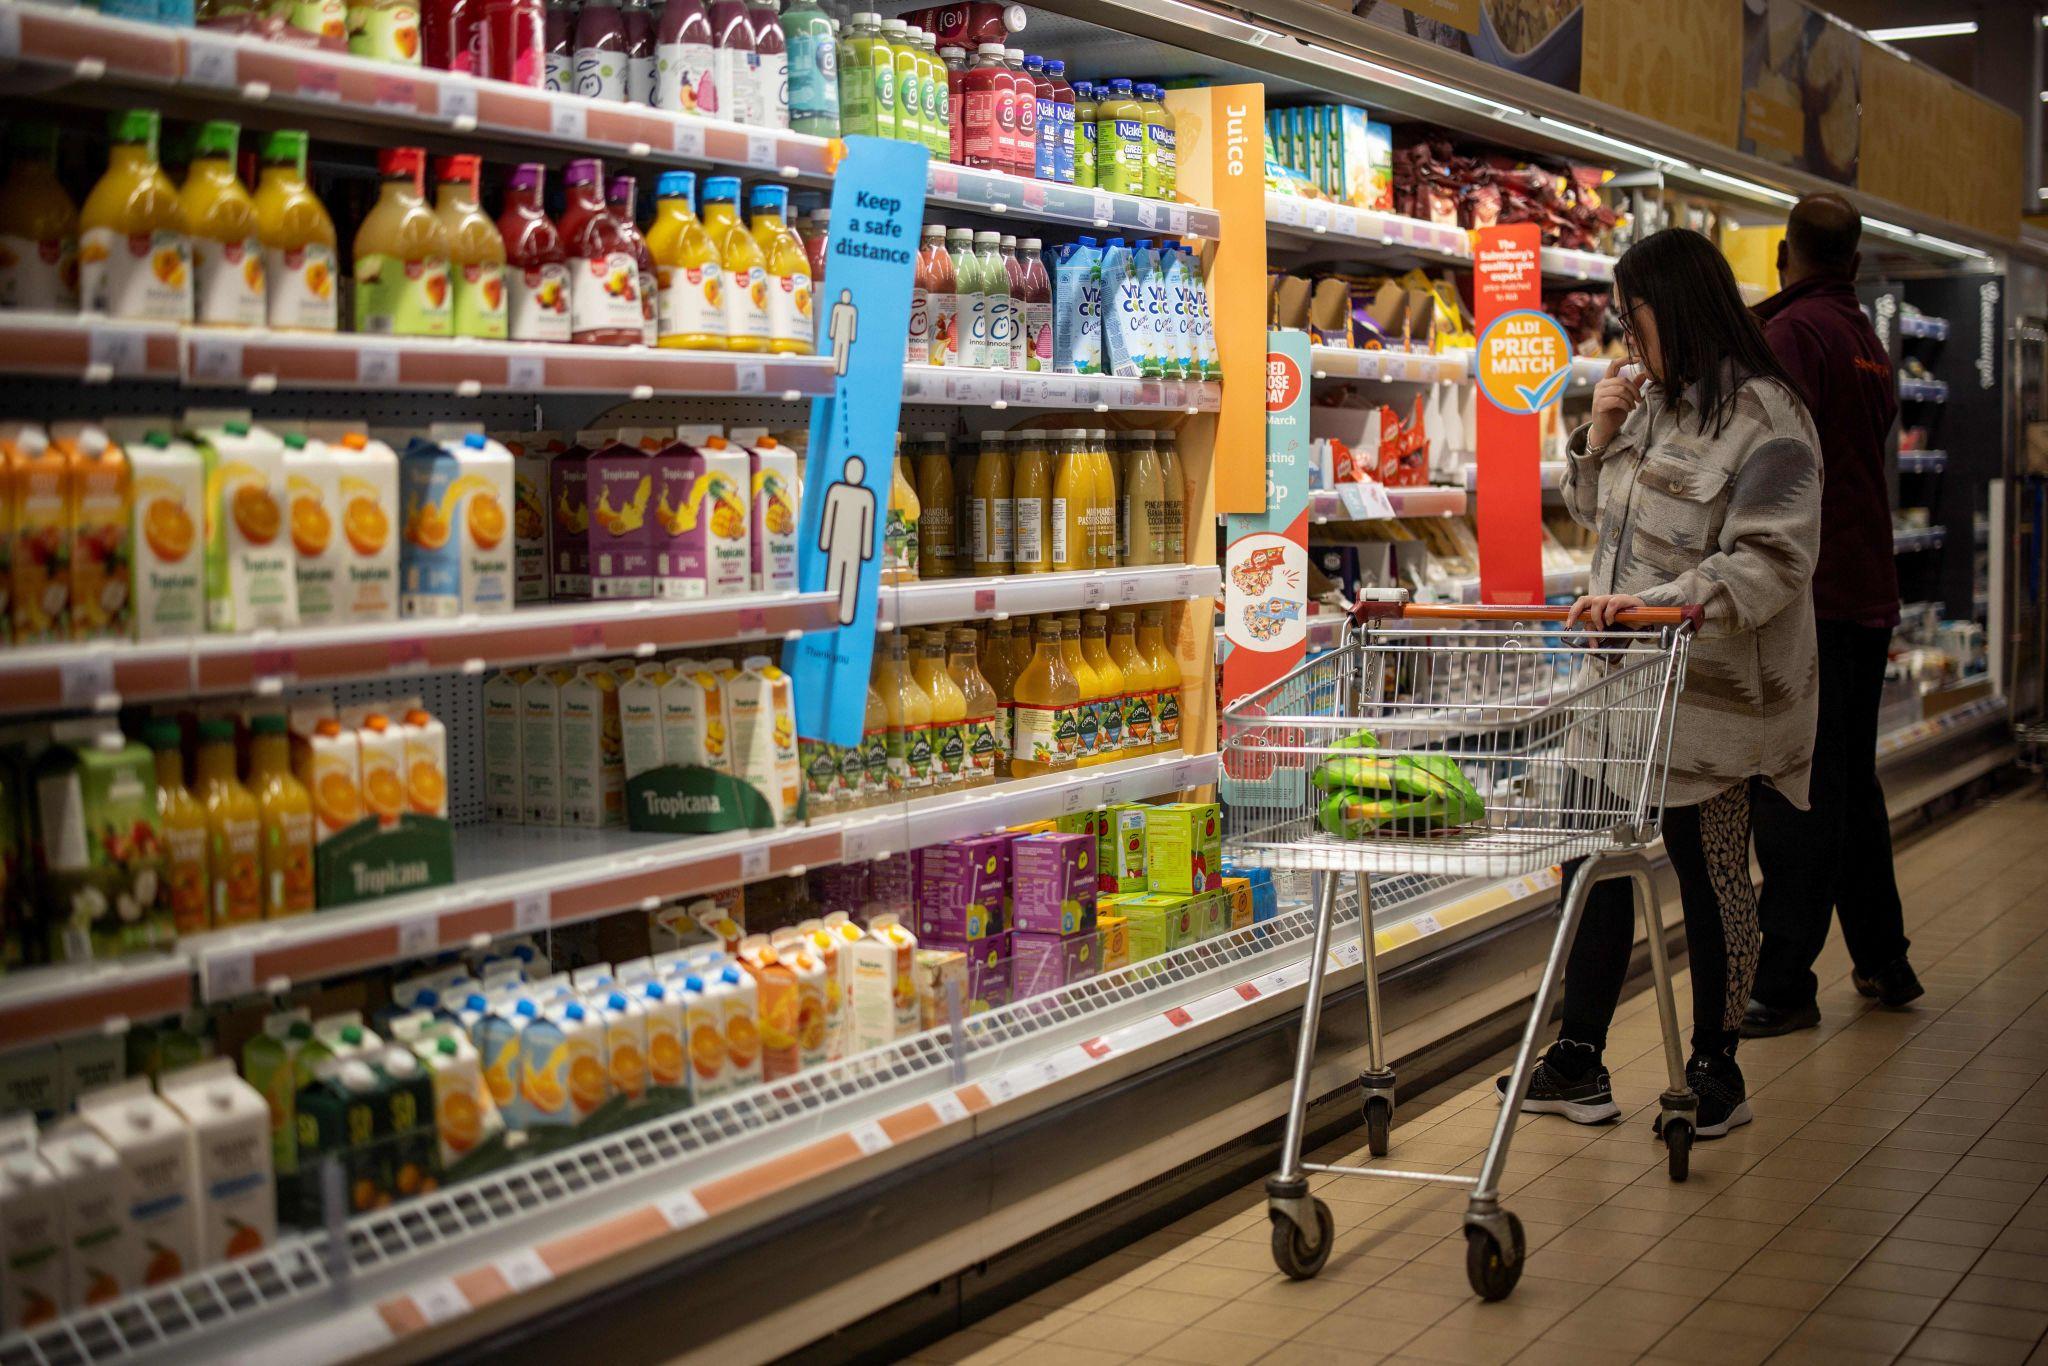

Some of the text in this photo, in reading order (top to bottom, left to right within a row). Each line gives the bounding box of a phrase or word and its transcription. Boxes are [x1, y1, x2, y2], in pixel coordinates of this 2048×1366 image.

[1036, 101, 1054, 116] Nake
[1057, 106, 1075, 121] Nake
[1120, 122, 1142, 137] Nake
[1227, 104, 1248, 176] Juice
[856, 191, 901, 216] Keep
[849, 218, 902, 238] a safe
[836, 237, 910, 265] distance
[1498, 240, 1516, 250] The
[1479, 249, 1534, 261] Sainsbury's
[1479, 261, 1535, 273] quality you
[1490, 272, 1523, 283] expect
[1505, 321, 1540, 335] ALDI
[987, 339, 1010, 347] innocen
[1490, 338, 1556, 356] PRICE
[1491, 357, 1556, 374] MATCH
[1266, 375, 1290, 390] OSE
[1266, 452, 1296, 466] ating
[601, 468, 640, 482] Tropicana
[806, 645, 831, 660] Thank
[1132, 703, 1150, 717] COPELLA
[642, 790, 721, 820] Tropicana
